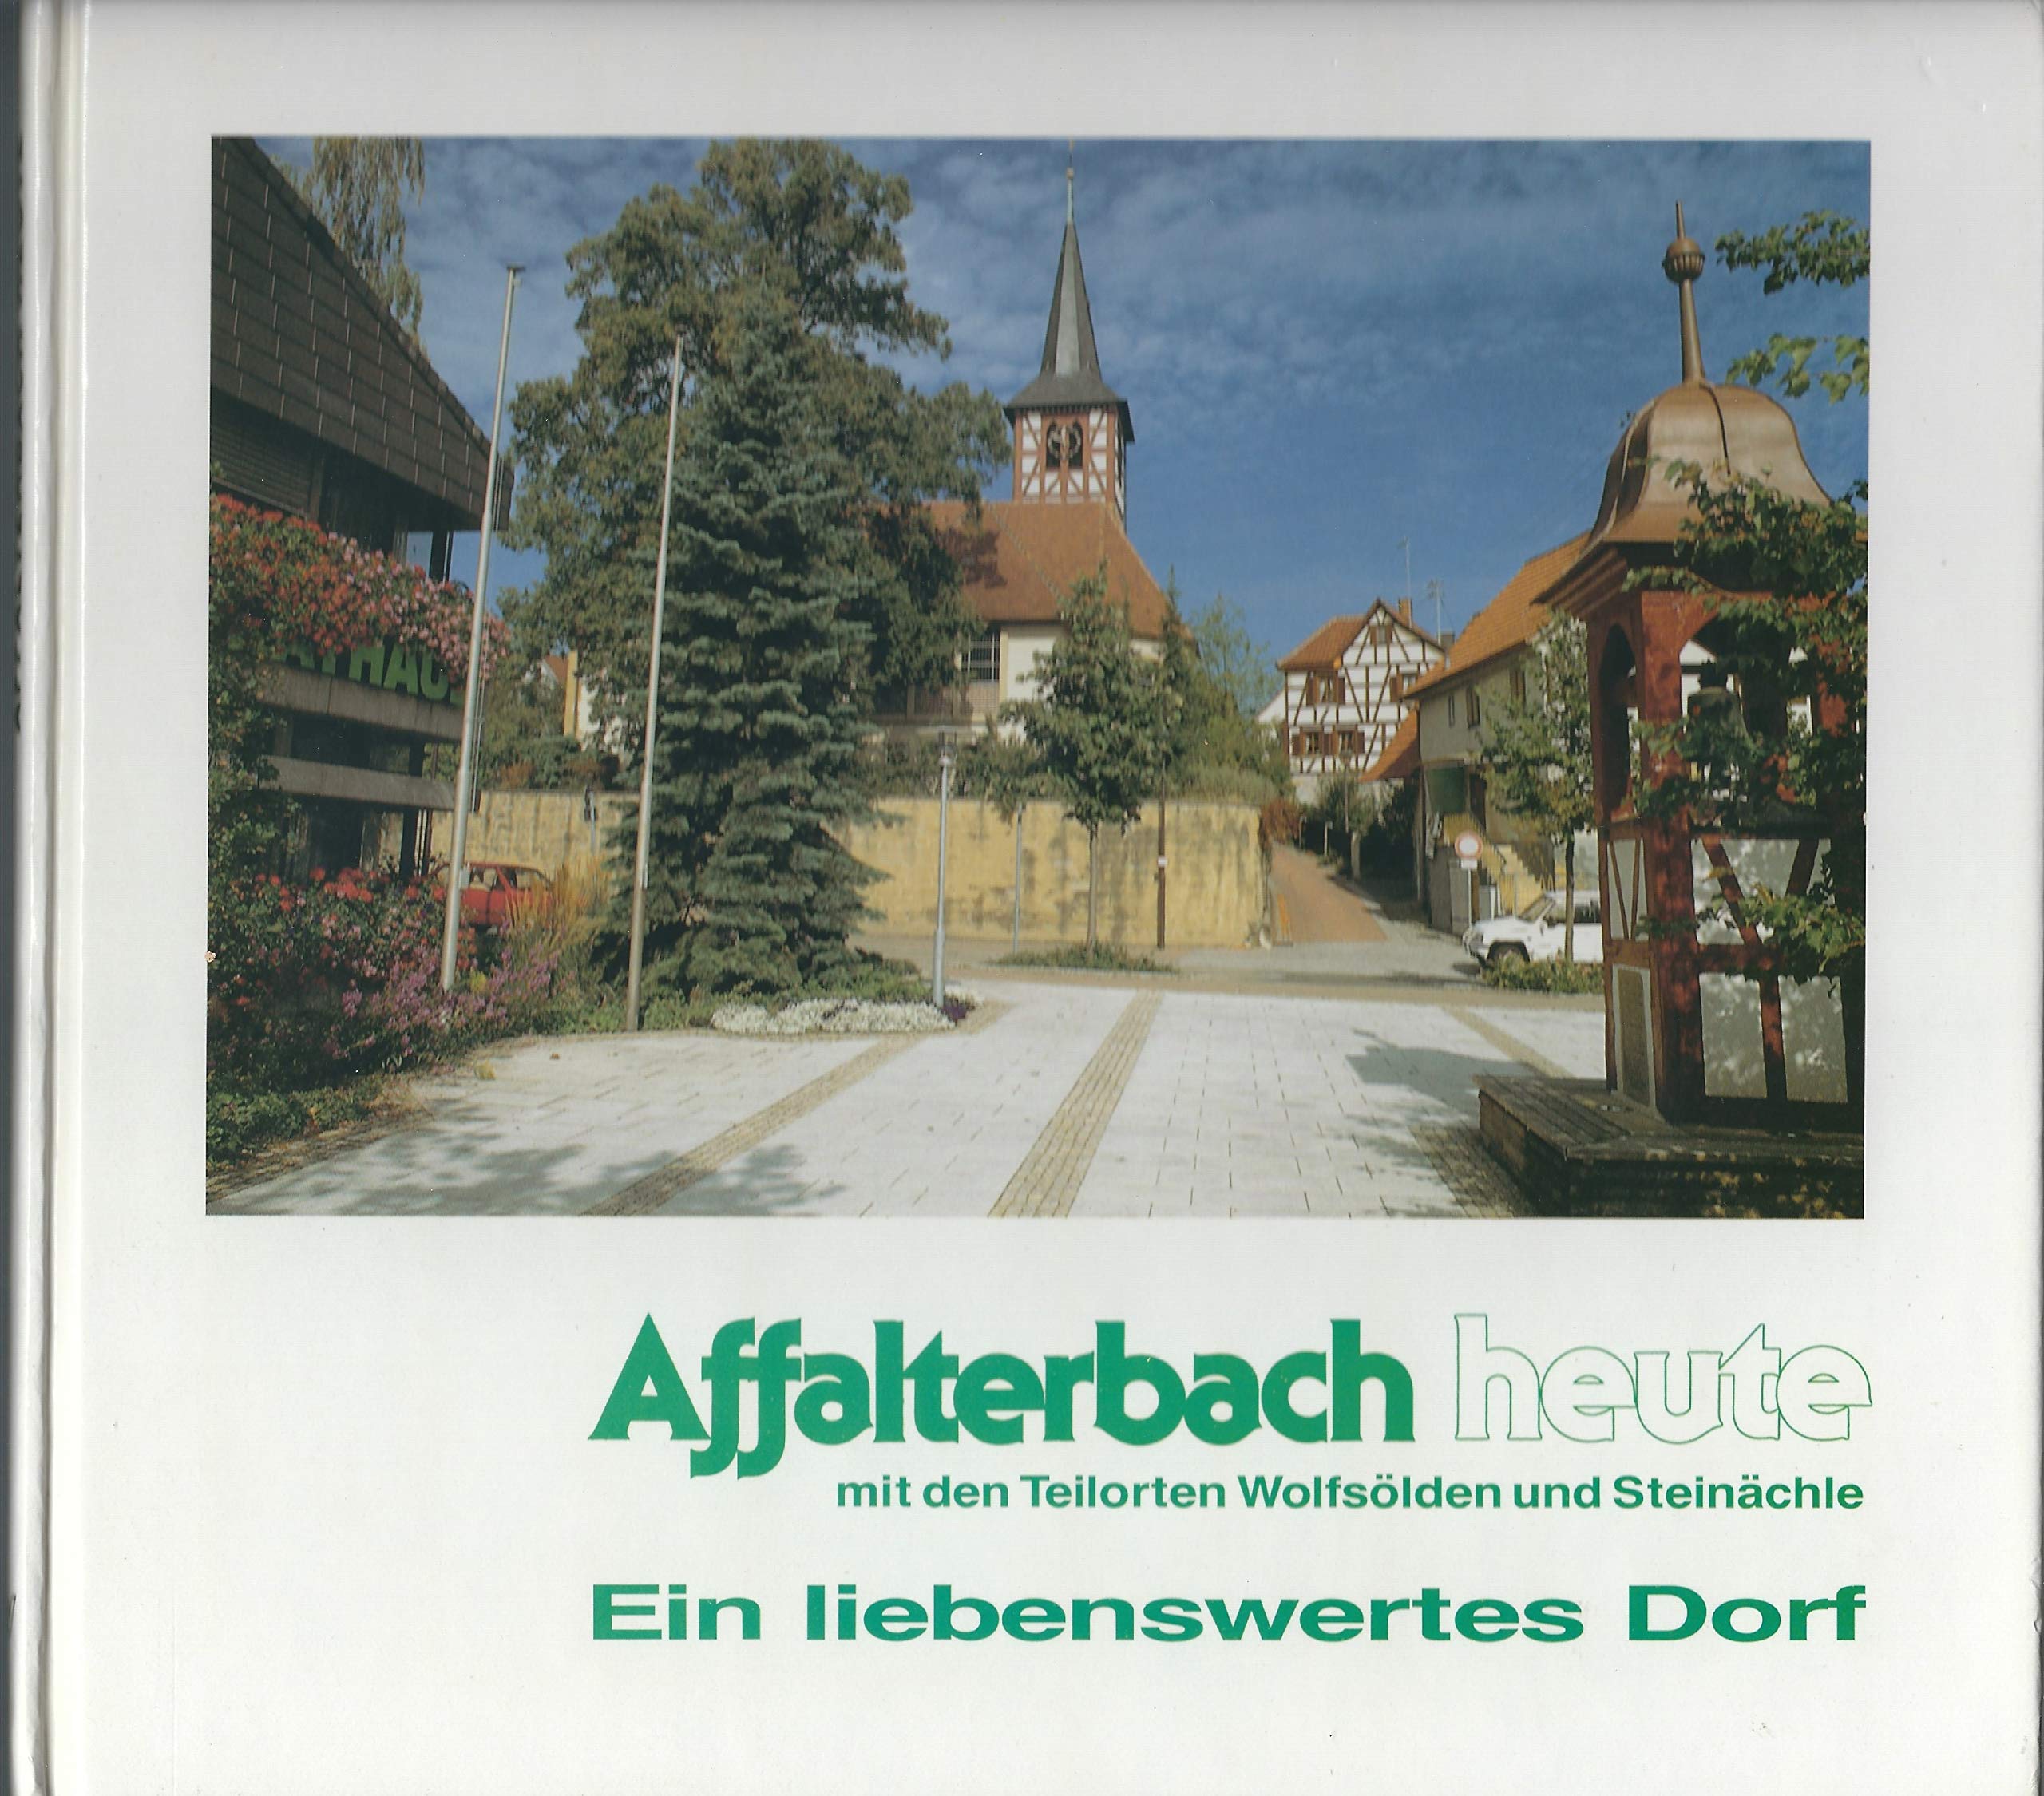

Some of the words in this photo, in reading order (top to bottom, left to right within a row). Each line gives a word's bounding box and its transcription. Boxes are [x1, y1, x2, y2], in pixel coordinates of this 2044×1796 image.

[588, 1313, 1416, 1479] Affalterbach
[1454, 1313, 1873, 1443] heute
[837, 1474, 912, 1508] mit
[922, 1474, 1009, 1509] den
[1020, 1474, 1226, 1509] Teilorten
[1238, 1474, 1502, 1509] Wolfsölden
[1513, 1475, 1602, 1509] und
[1613, 1473, 1864, 1509] Steinächle
[592, 1583, 761, 1641] Ein
[806, 1583, 1585, 1643] liebenswertes
[1628, 1584, 1868, 1643] Dorf
